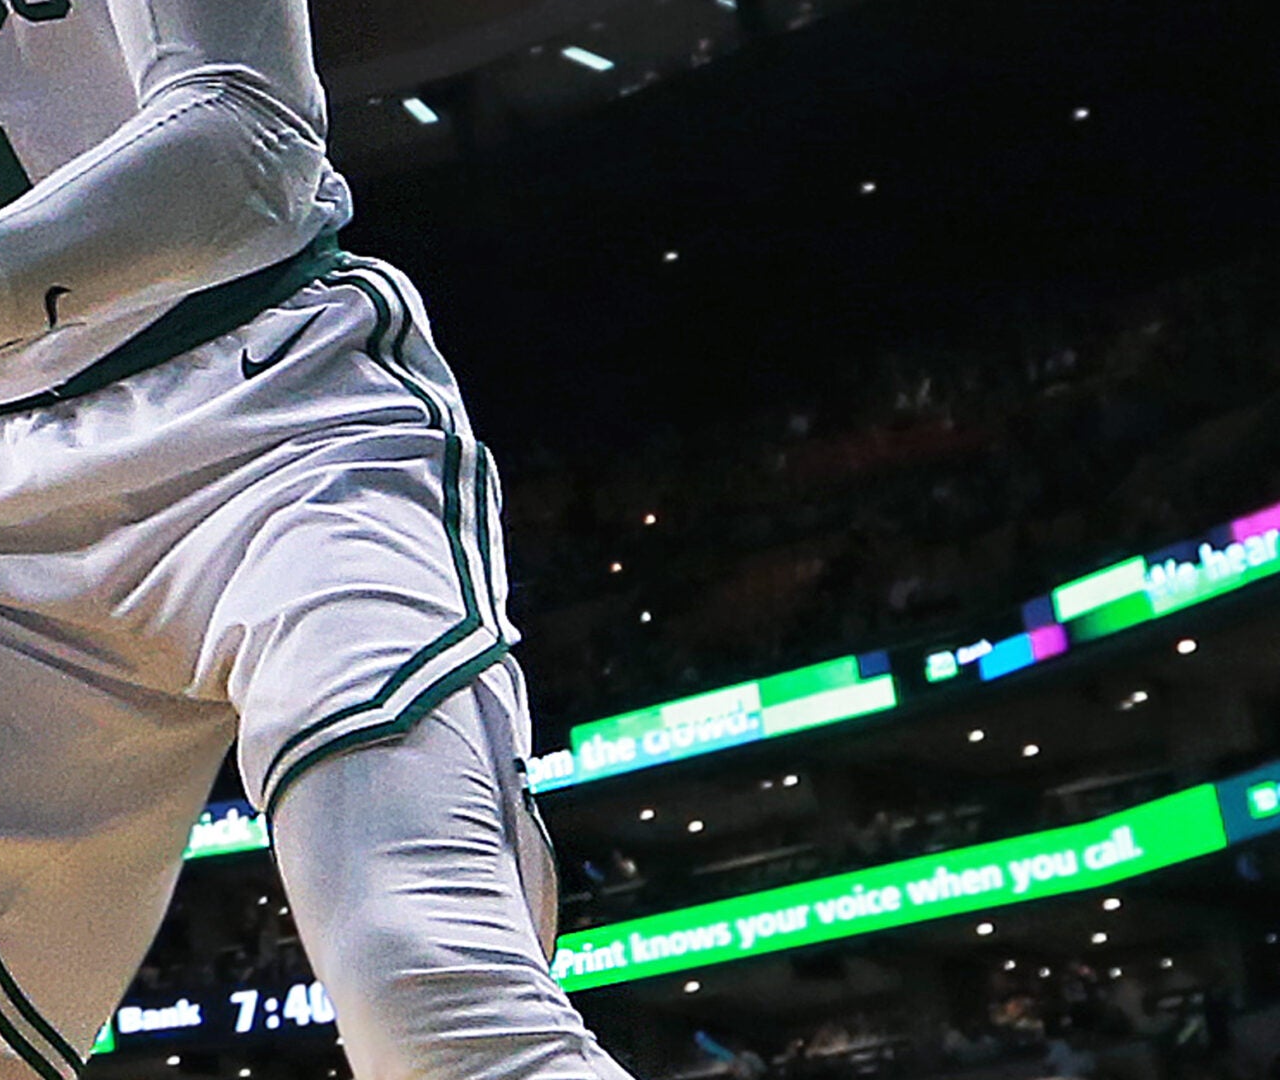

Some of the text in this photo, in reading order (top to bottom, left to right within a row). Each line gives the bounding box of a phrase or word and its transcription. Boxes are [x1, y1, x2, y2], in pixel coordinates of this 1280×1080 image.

[1199, 529, 1279, 580] hear
[580, 734, 636, 770] the
[551, 825, 1144, 980] Print knows your voice when you call.
[117, 998, 201, 1034] Bank
